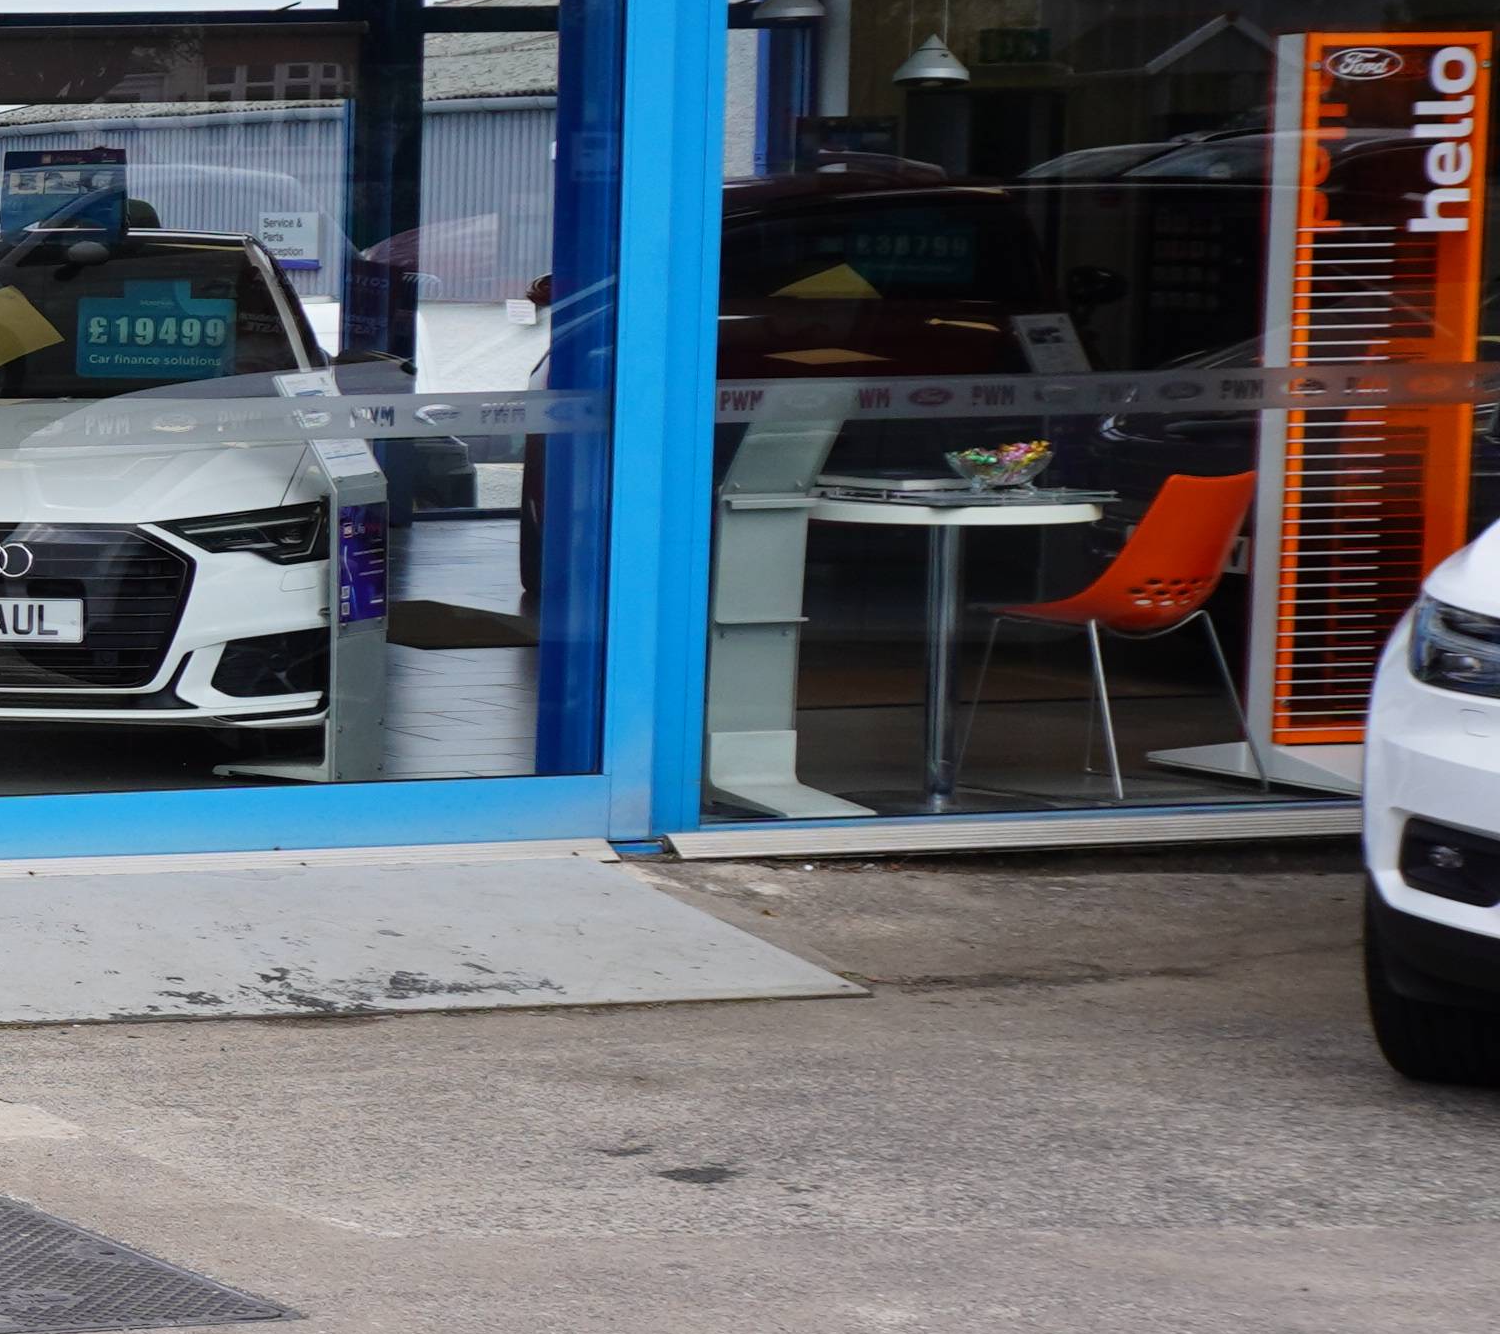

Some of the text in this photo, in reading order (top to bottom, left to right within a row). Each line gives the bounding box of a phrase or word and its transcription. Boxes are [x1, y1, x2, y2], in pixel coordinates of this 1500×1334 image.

[1333, 49, 1397, 77] Ford
[1407, 46, 1478, 233] hello
[263, 218, 294, 228] Service
[263, 232, 284, 242] Parts
[265, 247, 303, 257] eception
[88, 316, 226, 347] £19499
[89, 354, 222, 366] Car finance solutions
